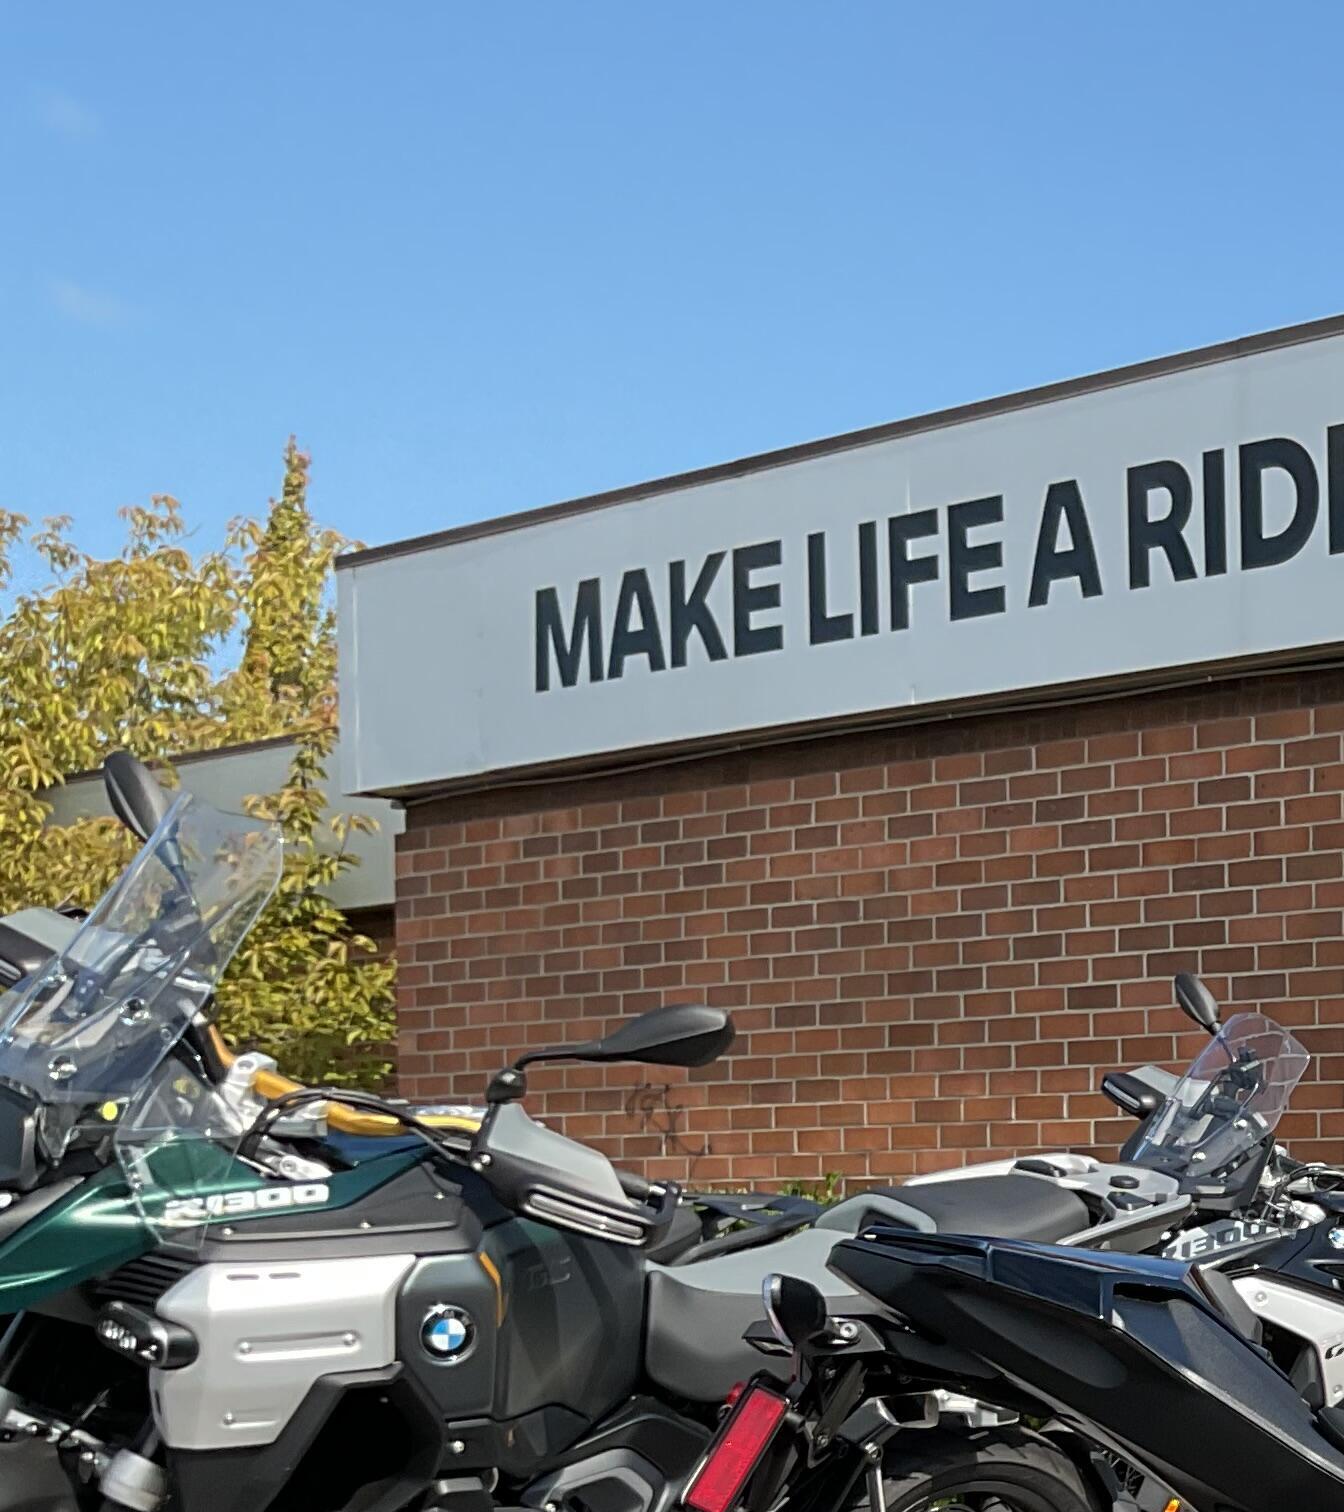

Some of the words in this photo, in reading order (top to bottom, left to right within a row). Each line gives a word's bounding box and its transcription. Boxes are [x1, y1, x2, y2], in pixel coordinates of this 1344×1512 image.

[535, 539, 783, 693] MAKE
[807, 494, 1007, 647] LIFE
[1028, 479, 1103, 608] A
